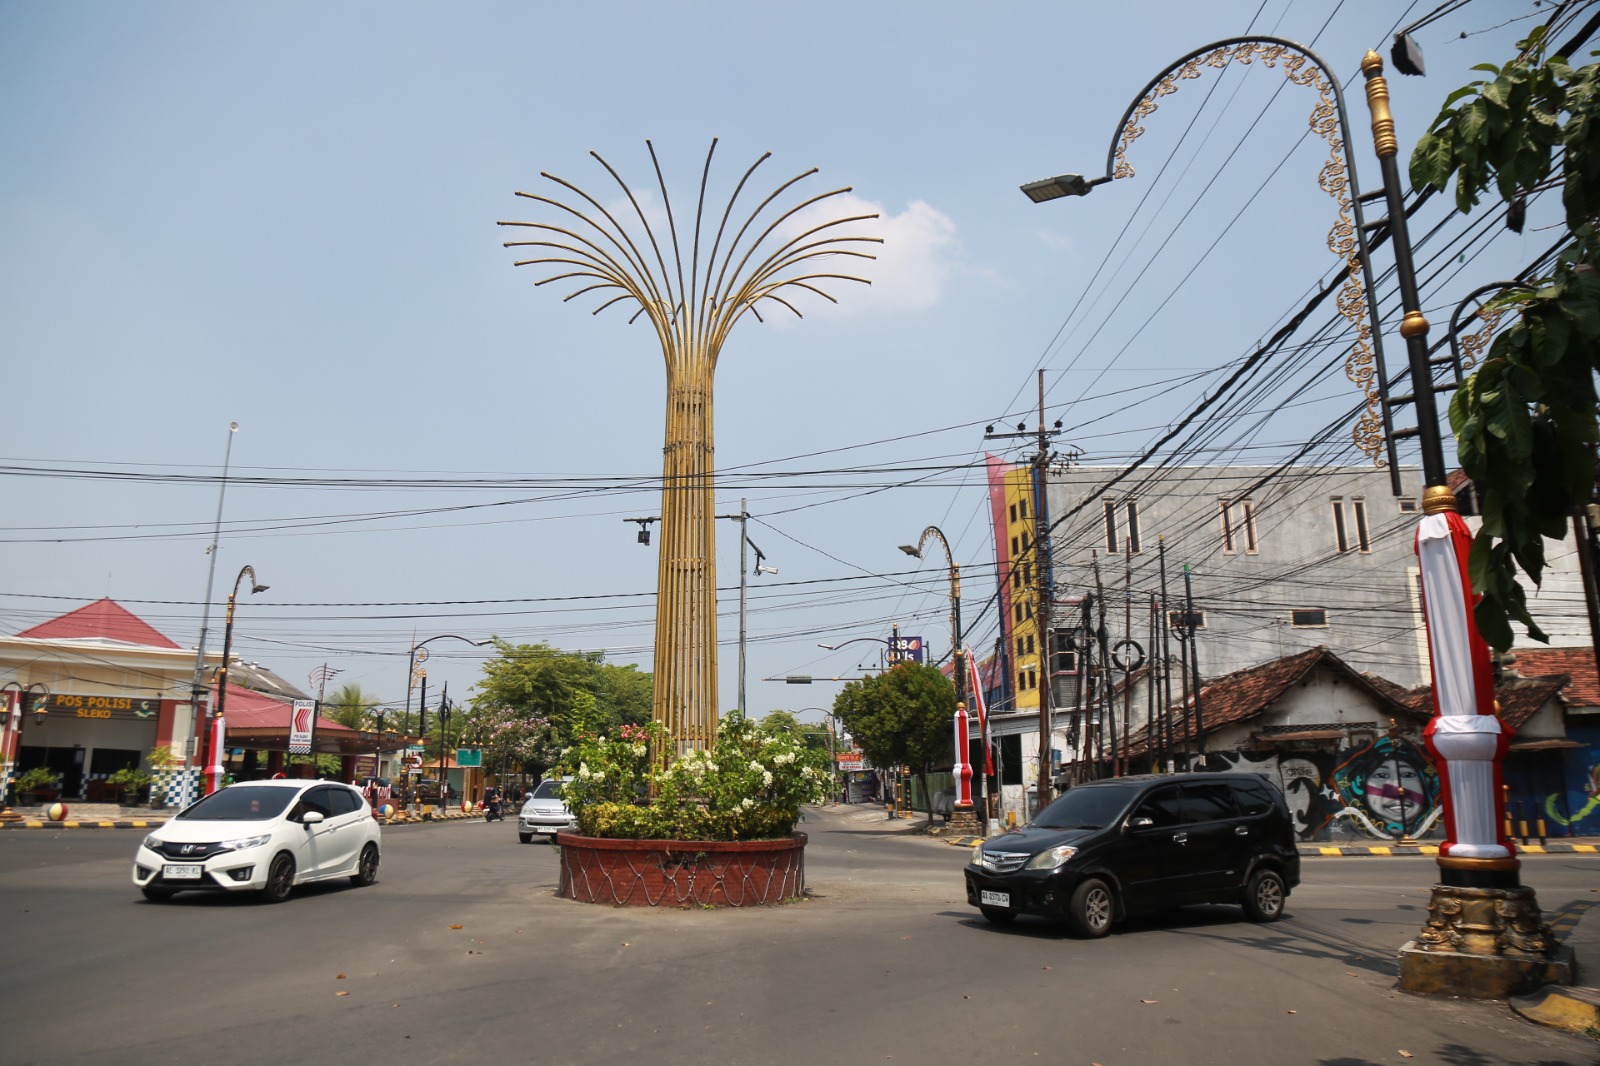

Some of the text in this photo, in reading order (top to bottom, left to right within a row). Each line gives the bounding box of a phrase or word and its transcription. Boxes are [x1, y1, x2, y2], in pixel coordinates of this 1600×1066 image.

[56, 694, 132, 709] POS POLISI
[76, 708, 112, 719] SLEKO
